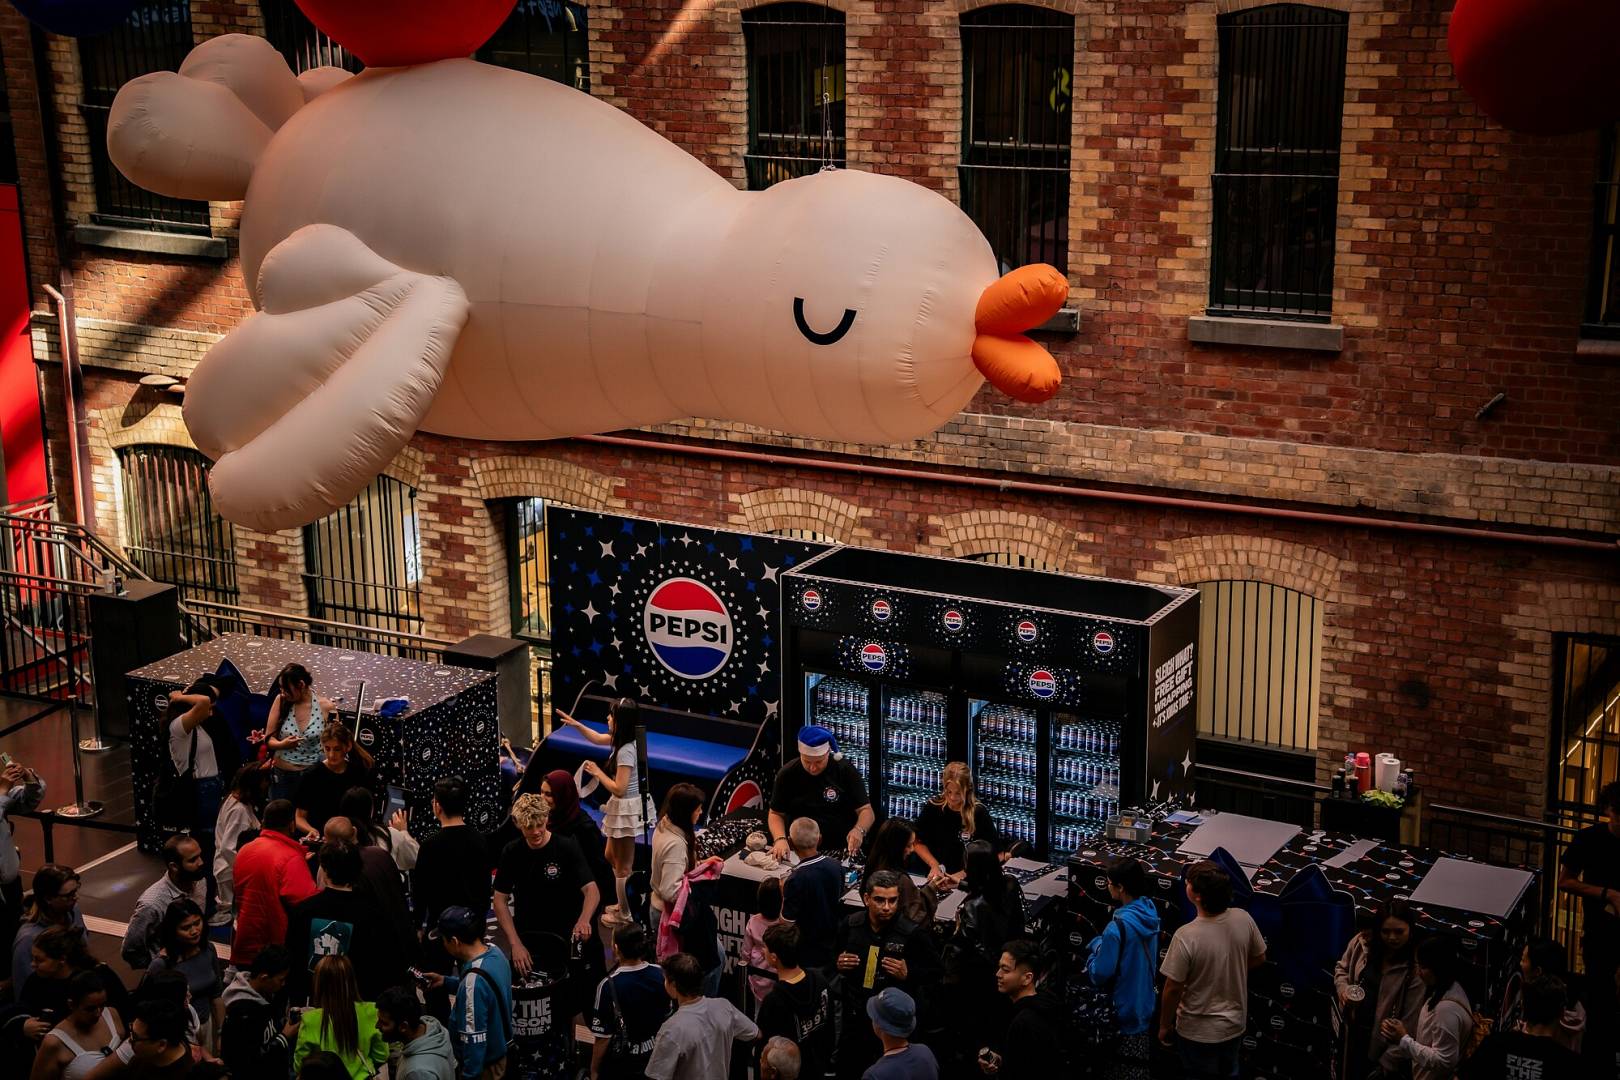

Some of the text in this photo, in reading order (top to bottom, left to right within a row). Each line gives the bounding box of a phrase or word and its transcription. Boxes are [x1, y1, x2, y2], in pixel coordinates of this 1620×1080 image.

[649, 612, 728, 645] PEPSI
[862, 653, 885, 662] PEPSI
[1154, 659, 1194, 703] FREE GIFT
[1155, 656, 1175, 686] SLEIGH
[1030, 680, 1054, 689] PEPSI
[1154, 676, 1193, 714] WRAPPING
[519, 996, 551, 1018] THE
[1505, 1053, 1544, 1069] FIZZ
